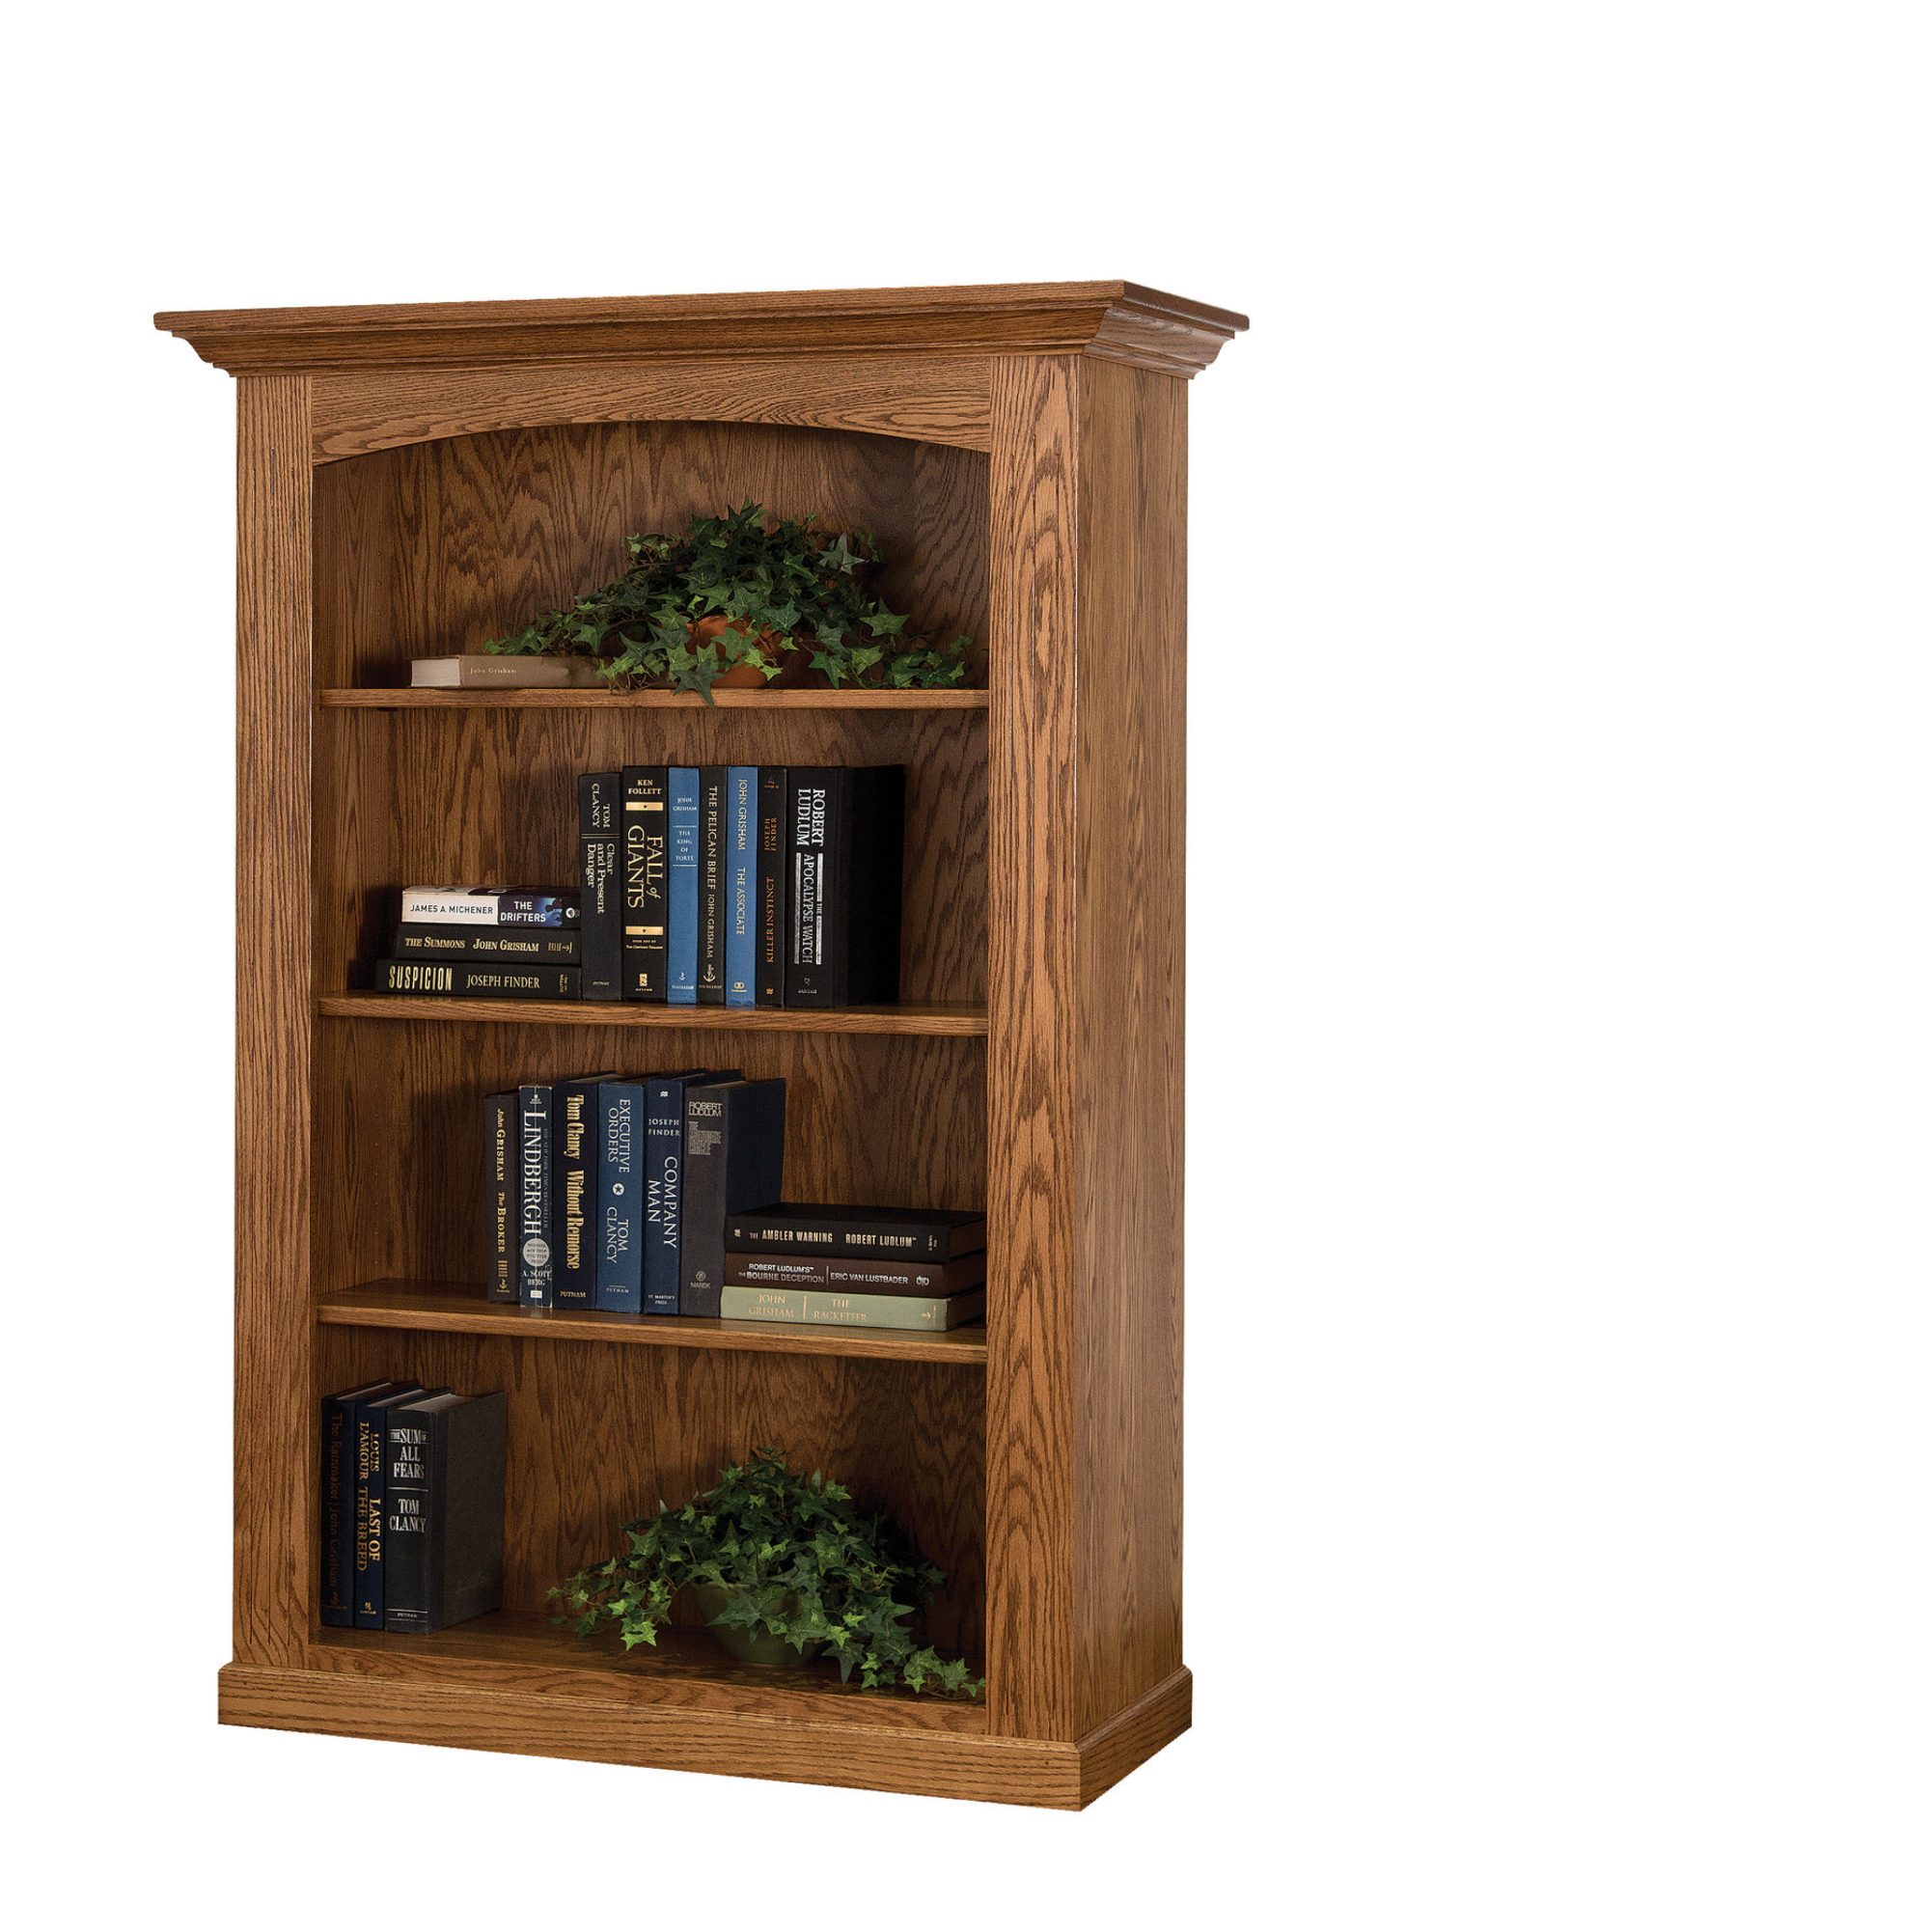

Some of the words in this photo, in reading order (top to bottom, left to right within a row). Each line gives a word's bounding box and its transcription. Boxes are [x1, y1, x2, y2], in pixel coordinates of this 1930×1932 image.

[592, 783, 600, 828] CLANCY
[708, 786, 718, 808] THE
[738, 779, 747, 805] JOHN
[602, 803, 611, 828] TOM
[737, 807, 747, 850] GRISHAM
[796, 787, 811, 846] LUDLUM
[812, 788, 826, 846] ROBERT
[707, 811, 717, 857] PELICAN
[586, 843, 596, 888] Danger
[596, 842, 606, 867] and
[606, 842, 616, 875] Clear
[627, 824, 645, 908] GIANTS
[647, 835, 664, 885] FALL
[706, 860, 717, 890] BRIEF
[736, 867, 746, 885] THE
[802, 853, 815, 923] APOCALYPSE
[513, 900, 533, 910] THE
[596, 869, 606, 914] Present
[646, 886, 661, 899] of
[706, 894, 715, 918] JOHN
[410, 904, 438, 913] JAMES
[449, 905, 493, 915] MICHENER
[500, 912, 546, 923] DRIFTERS
[736, 888, 746, 935] ASSOCIATE
[404, 937, 423, 947] THE
[473, 938, 498, 951] JOHN
[500, 939, 539, 952] GRISHAM
[706, 919, 715, 958] GRISHAM
[801, 925, 813, 964] WATCH
[388, 965, 453, 991] SUSPICION
[466, 974, 502, 988] JOSEPH
[504, 975, 540, 989] FINDER
[566, 1094, 585, 1120] Tom
[688, 1101, 723, 1110] ROBERT
[688, 1108, 722, 1117] LUDLUM
[564, 1122, 585, 1159] Clancy
[608, 1107, 619, 1163] ORDERS
[619, 1098, 631, 1173] EXECUTIVE
[648, 1128, 681, 1137] FINDER
[496, 1128, 506, 1181] GRISHAM
[523, 1110, 546, 1235] LINDBERGH
[566, 1170, 585, 1215] Without
[648, 1179, 661, 1223] MAN
[664, 1156, 677, 1249] COMPANY
[497, 1207, 507, 1253] BROKER
[566, 1217, 585, 1269] Remorse
[606, 1206, 618, 1263] CLANCY
[618, 1219, 628, 1252] TOM
[762, 1228, 793, 1241] AMBLER
[796, 1230, 833, 1243] WARNING
[845, 1233, 876, 1245] ROBERT
[747, 1272, 780, 1281] BOURNE
[781, 1274, 824, 1283] DECEPTION
[830, 1272, 848, 1281] ERIC
[849, 1273, 864, 1282] VAN
[865, 1274, 908, 1284] LUSTBADER
[748, 1306, 794, 1318] GRISHAM
[758, 1294, 786, 1304] JOHN
[832, 1298, 850, 1309] THE
[813, 1311, 867, 1321] RACKETEER
[331, 1413, 343, 1437] The
[390, 1431, 400, 1440] THE
[400, 1427, 422, 1445] SUM
[359, 1421, 370, 1480] L'AMOUR
[370, 1432, 380, 1473] LOUIS
[400, 1446, 421, 1462] ALL
[330, 1440, 343, 1499] Rainmaker
[393, 1462, 425, 1479] FEARS
[357, 1486, 369, 1518] THE
[369, 1498, 381, 1536] LAST
[398, 1498, 420, 1515] TOM
[389, 1515, 427, 1533] CLANCY
[356, 1522, 368, 1571] BREED
[369, 1539, 381, 1561] OF
